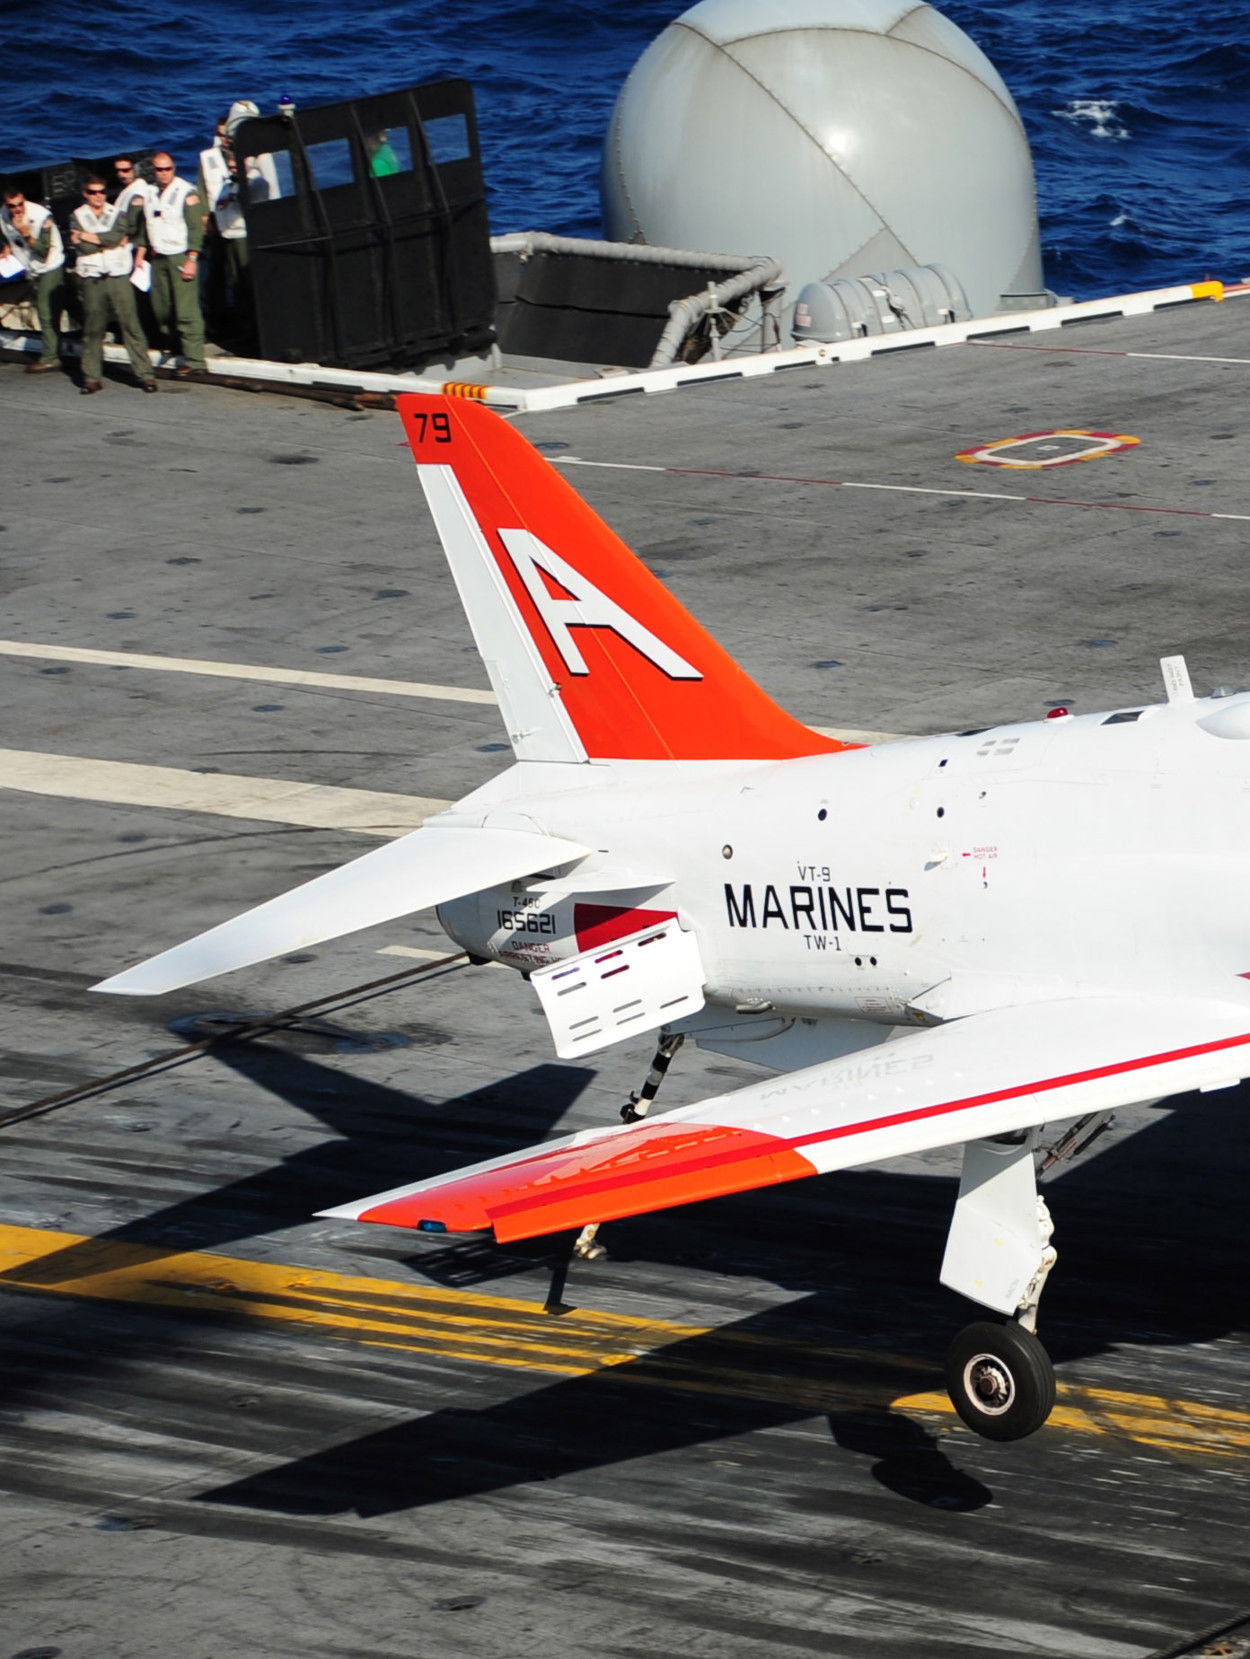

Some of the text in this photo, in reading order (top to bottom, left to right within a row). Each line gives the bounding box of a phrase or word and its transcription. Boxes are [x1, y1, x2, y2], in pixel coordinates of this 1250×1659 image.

[414, 413, 452, 443] 79
[497, 528, 704, 681] A
[798, 866, 831, 882] VT-9
[724, 883, 913, 933] MARINES
[497, 909, 556, 935] 165621
[511, 941, 550, 953] DANGER
[803, 934, 842, 951] TW-1
